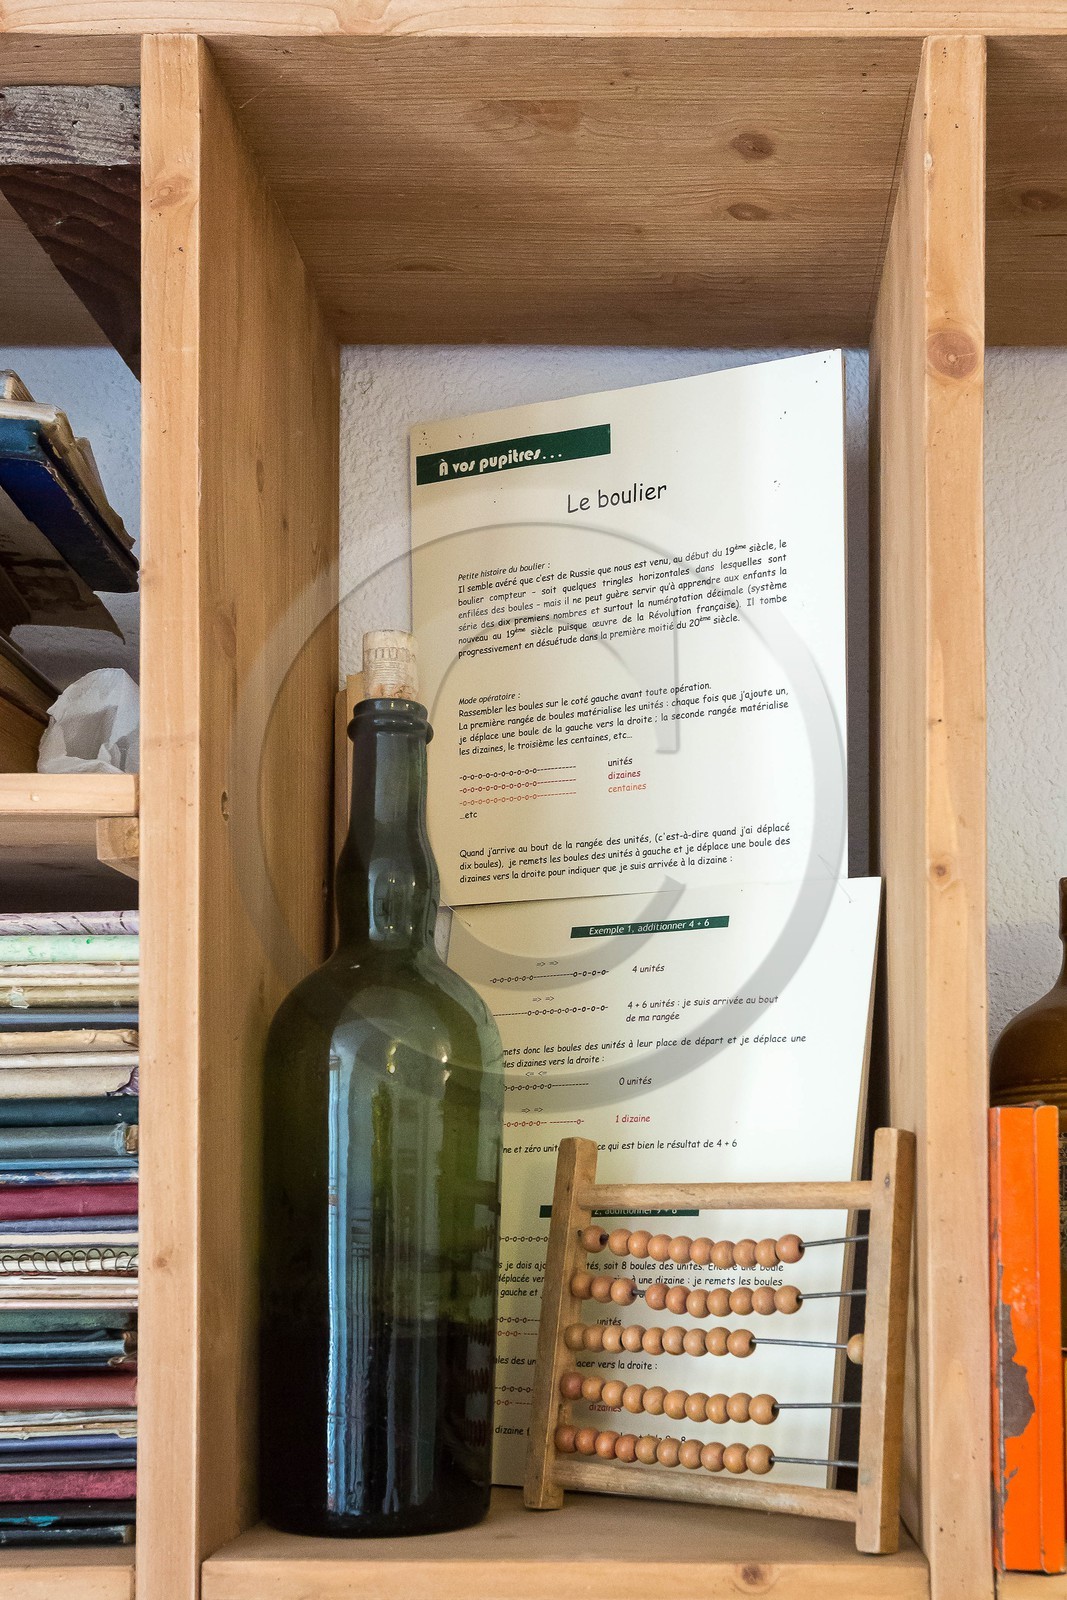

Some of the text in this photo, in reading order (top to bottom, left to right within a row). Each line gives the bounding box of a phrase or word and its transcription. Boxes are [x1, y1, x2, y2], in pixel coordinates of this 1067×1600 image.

[439, 459, 448, 476] À
[452, 460, 476, 473] vos
[567, 483, 666, 513] Le boulier
[457, 572, 478, 581] Petite
[480, 567, 506, 577] histoire
[508, 565, 517, 573] du
[519, 562, 545, 571] boulier
[458, 584, 464, 593] Il
[467, 580, 493, 592] semble
[494, 576, 517, 587] avéré
[519, 577, 533, 586] que
[535, 573, 554, 582] c'est
[556, 571, 567, 580] de
[569, 567, 595, 577] Russie
[597, 566, 611, 576] que
[613, 563, 631, 572] nous
[633, 560, 646, 568] est
[649, 558, 670, 566] venu,
[685, 550, 709, 561] début
[711, 548, 722, 557] du
[749, 541, 776, 552] siècle,
[779, 539, 786, 548] le
[458, 696, 477, 704] Mode
[478, 692, 515, 704] opératoire
[458, 747, 469, 755] les
[471, 744, 505, 754] dizaines,
[507, 742, 514, 750] le
[517, 739, 554, 749] troisième
[556, 737, 568, 745] les
[570, 734, 611, 744] centaines,
[607, 756, 632, 766] unités
[607, 770, 640, 779] dizaines
[607, 783, 646, 792] centaines
[459, 847, 484, 858] Quand
[486, 846, 515, 857] j'arrive
[530, 843, 548, 851] bout
[552, 841, 562, 850] de
[565, 840, 572, 848] la
[575, 838, 603, 849] rangée
[606, 837, 620, 845] des
[623, 834, 651, 844] unités,
[711, 826, 736, 839] quand
[739, 825, 752, 837] j'ai
[756, 822, 790, 834] déplacé
[459, 874, 490, 883] dizaines
[511, 870, 518, 878] la
[520, 869, 545, 878] droite
[548, 869, 565, 878] pour
[568, 865, 600, 875] indiquer
[602, 865, 616, 874] que
[620, 862, 627, 873] je
[629, 861, 645, 870] suis
[647, 858, 678, 868] arrivée
[680, 857, 685, 866] à
[687, 856, 695, 865] la
[697, 855, 727, 865] dizaine
[589, 925, 625, 935] Exemple
[637, 920, 686, 932] additionner
[704, 918, 709, 926] 6
[639, 963, 664, 972] unités
[627, 1001, 632, 1009] 4
[641, 1000, 647, 1008] 6
[649, 998, 675, 1008] unités
[681, 998, 691, 1008] je
[693, 997, 710, 1006] suis
[712, 996, 743, 1005] arrivée
[758, 992, 778, 1003] bout
[625, 1013, 635, 1022] de
[651, 1011, 679, 1022] rangée
[522, 1046, 540, 1054] donc
[543, 1044, 554, 1052] les
[557, 1043, 581, 1052] boules
[584, 1042, 598, 1050] des
[601, 1039, 625, 1049] unités
[628, 1039, 633, 1048] à
[636, 1039, 653, 1047] leur
[655, 1038, 677, 1049] place
[680, 1037, 691, 1045] de
[694, 1036, 723, 1046] départ
[727, 1035, 737, 1044] et
[739, 1035, 749, 1046] je
[753, 1034, 786, 1044] déplace
[516, 1058, 546, 1067] dizaines
[566, 1056, 573, 1064] la
[575, 1055, 599, 1064] droite
[618, 1075, 652, 1085] 0 unités
[615, 1114, 650, 1122] 1 dizaine
[513, 1144, 541, 1153] et zéro
[607, 1141, 619, 1152] qui
[621, 1141, 634, 1149] est
[636, 1140, 654, 1149] bien
[656, 1140, 664, 1148] le
[666, 1139, 700, 1148] résultat
[702, 1139, 713, 1147] de
[716, 1138, 721, 1147] 4
[731, 1138, 737, 1147] 6
[505, 1262, 513, 1271] je
[516, 1261, 531, 1269] dois
[630, 1261, 656, 1270] boules
[659, 1261, 672, 1271] des
[656, 1276, 684, 1284] dizaine
[693, 1276, 701, 1287] je
[739, 1276, 751, 1285] les
[754, 1277, 782, 1286] boules
[501, 1288, 530, 1298] gauche
[511, 1356, 525, 1365] des
[618, 1360, 624, 1369] la
[627, 1360, 652, 1370] droite
[495, 1425, 523, 1435] dizaine
